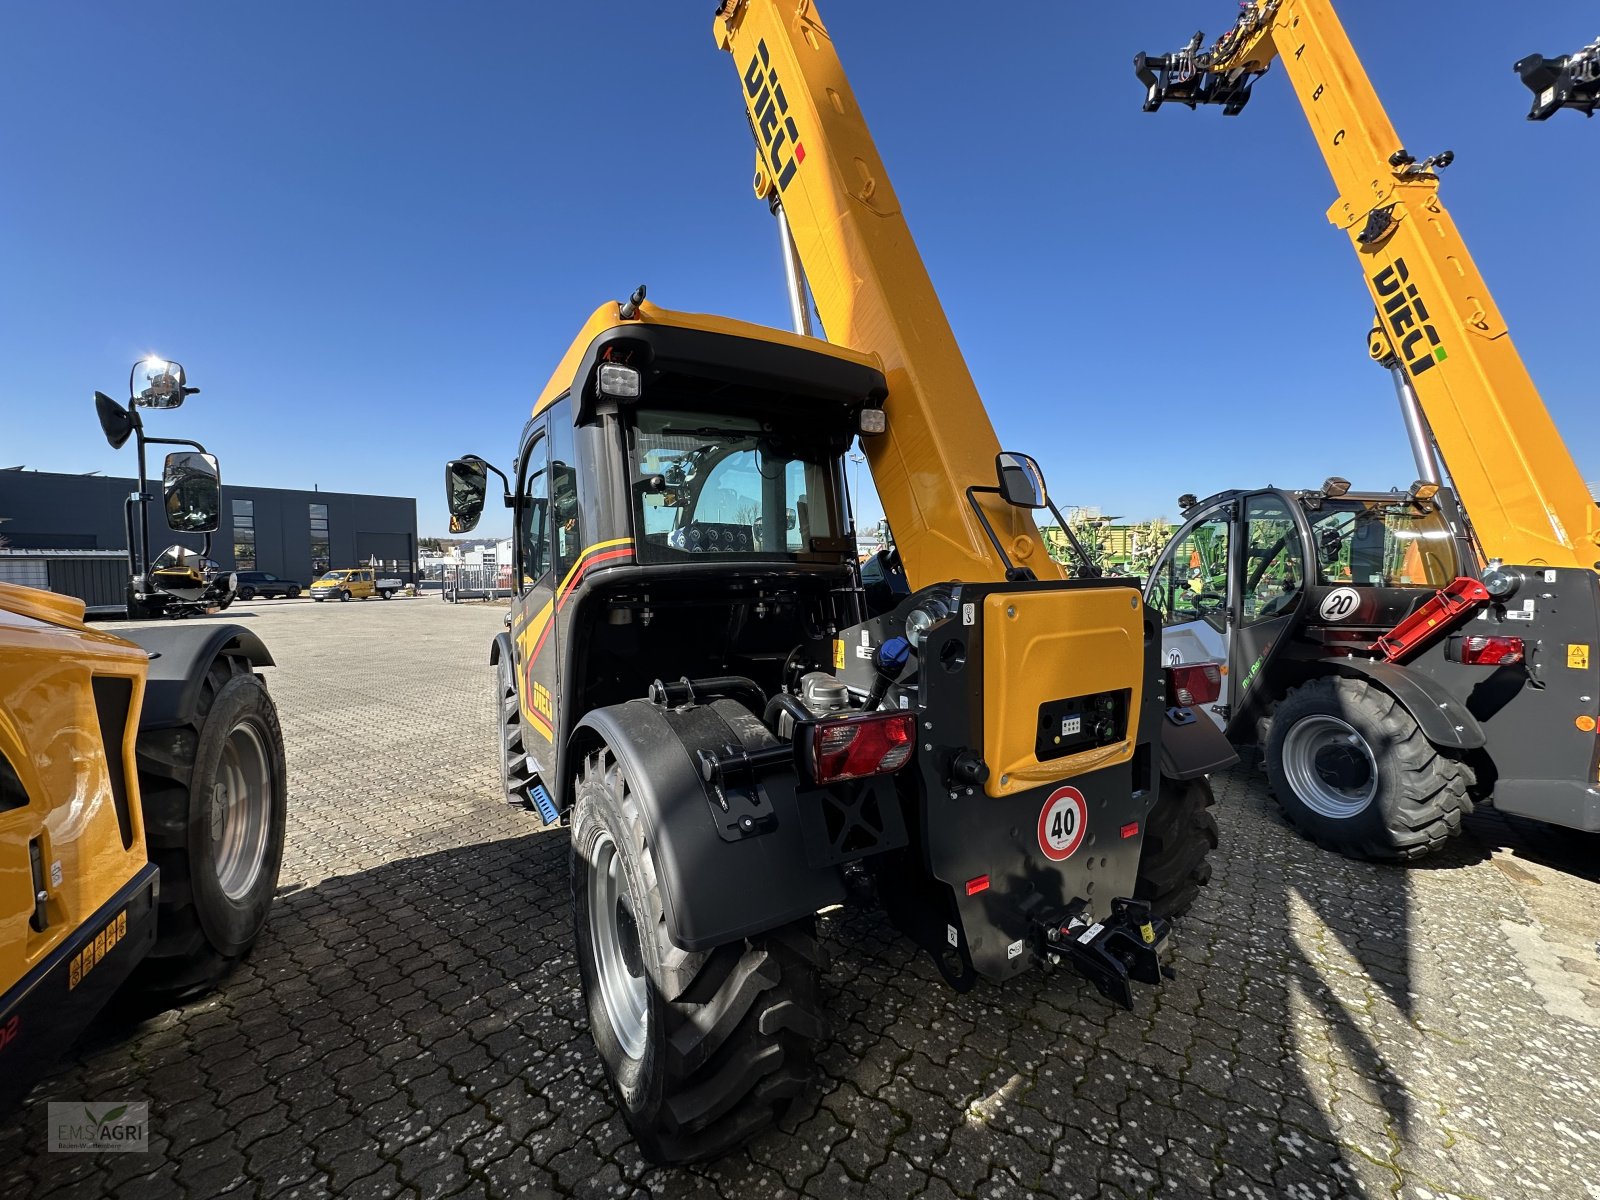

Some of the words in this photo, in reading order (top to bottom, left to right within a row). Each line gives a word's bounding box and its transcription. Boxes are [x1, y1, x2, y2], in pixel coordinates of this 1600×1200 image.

[1294, 43, 1306, 61] A
[1312, 83, 1324, 101] B
[1333, 129, 1345, 146] C
[1325, 594, 1353, 615] 20
[1051, 807, 1075, 839] 40
